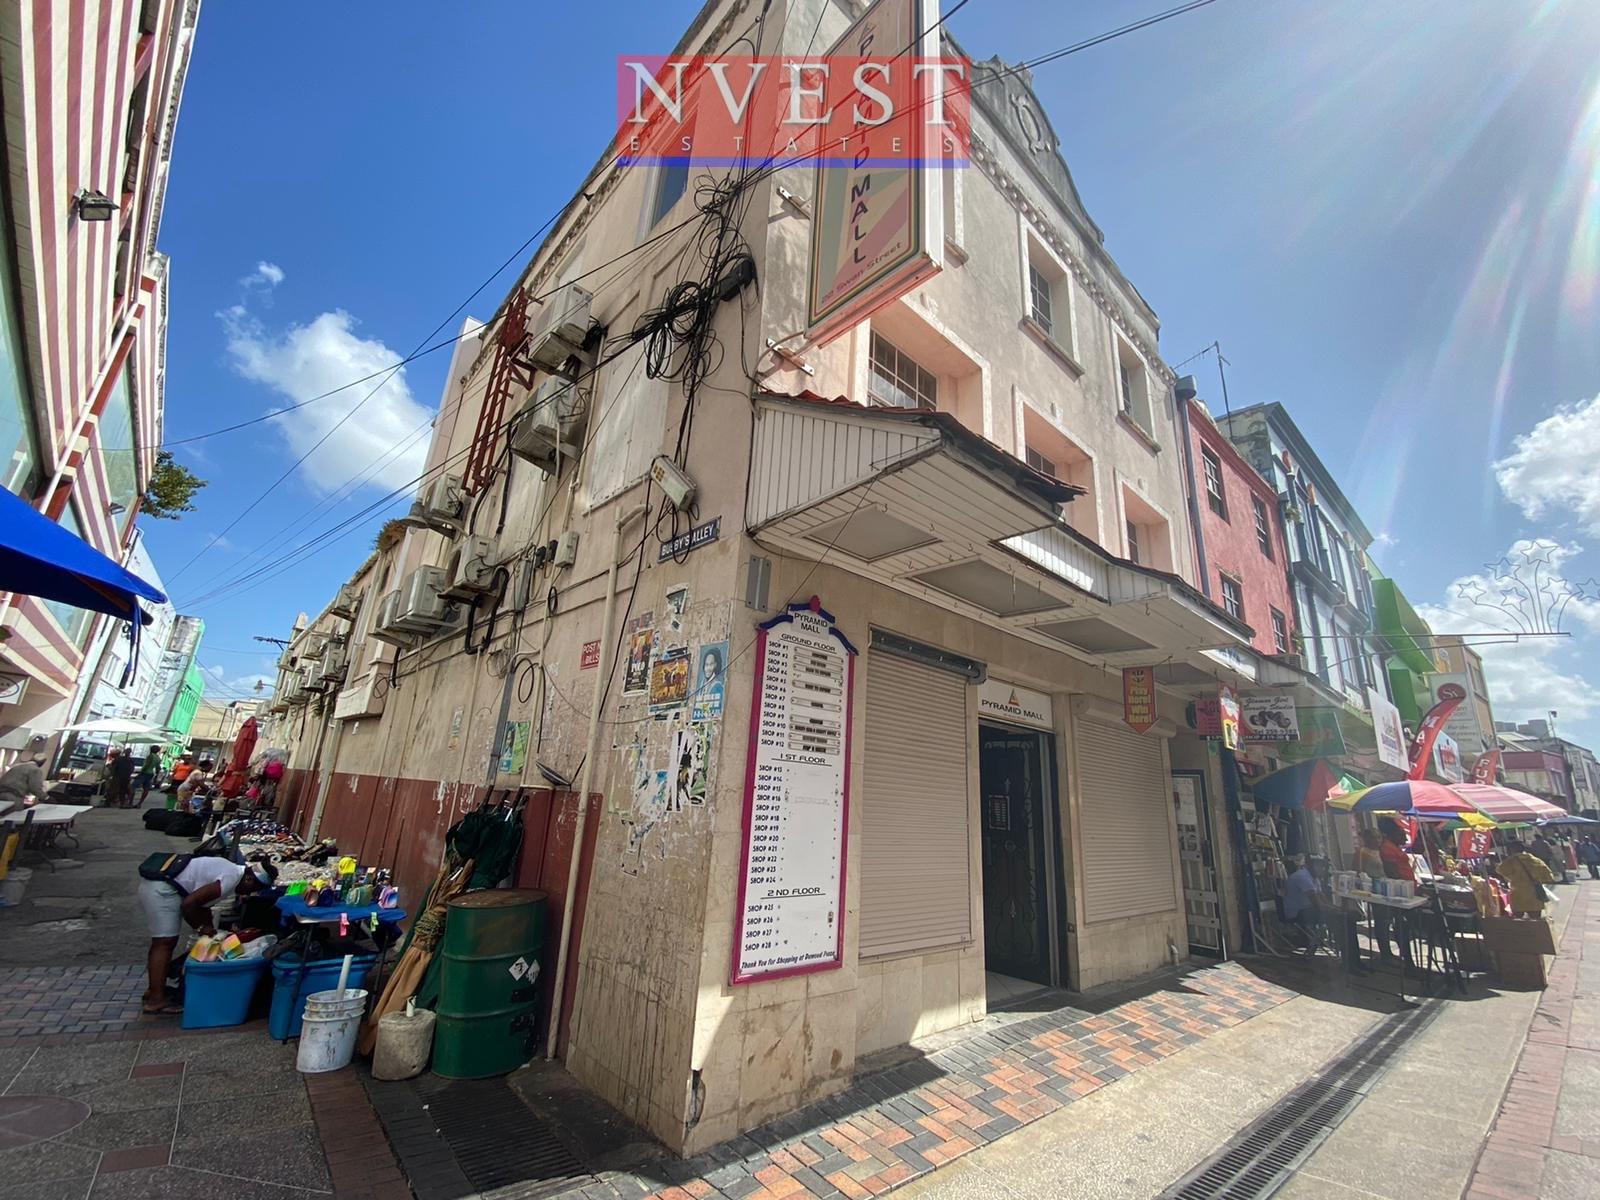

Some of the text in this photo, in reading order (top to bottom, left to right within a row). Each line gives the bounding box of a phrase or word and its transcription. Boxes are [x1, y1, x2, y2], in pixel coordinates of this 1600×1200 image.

[851, 173, 871, 264] MALL
[867, 242, 901, 269] Street
[692, 524, 714, 544] ALLEY
[794, 613, 828, 628] PYRAMID
[800, 623, 820, 634] MALL
[584, 642, 597, 654] POST
[781, 634, 836, 652] GROUND FLOOR
[982, 699, 1021, 715] PYRAMID
[1024, 710, 1044, 720] MALL
[799, 755, 826, 764] FLOOR
[742, 960, 756, 969] Thank
[776, 955, 798, 964] Shopping
